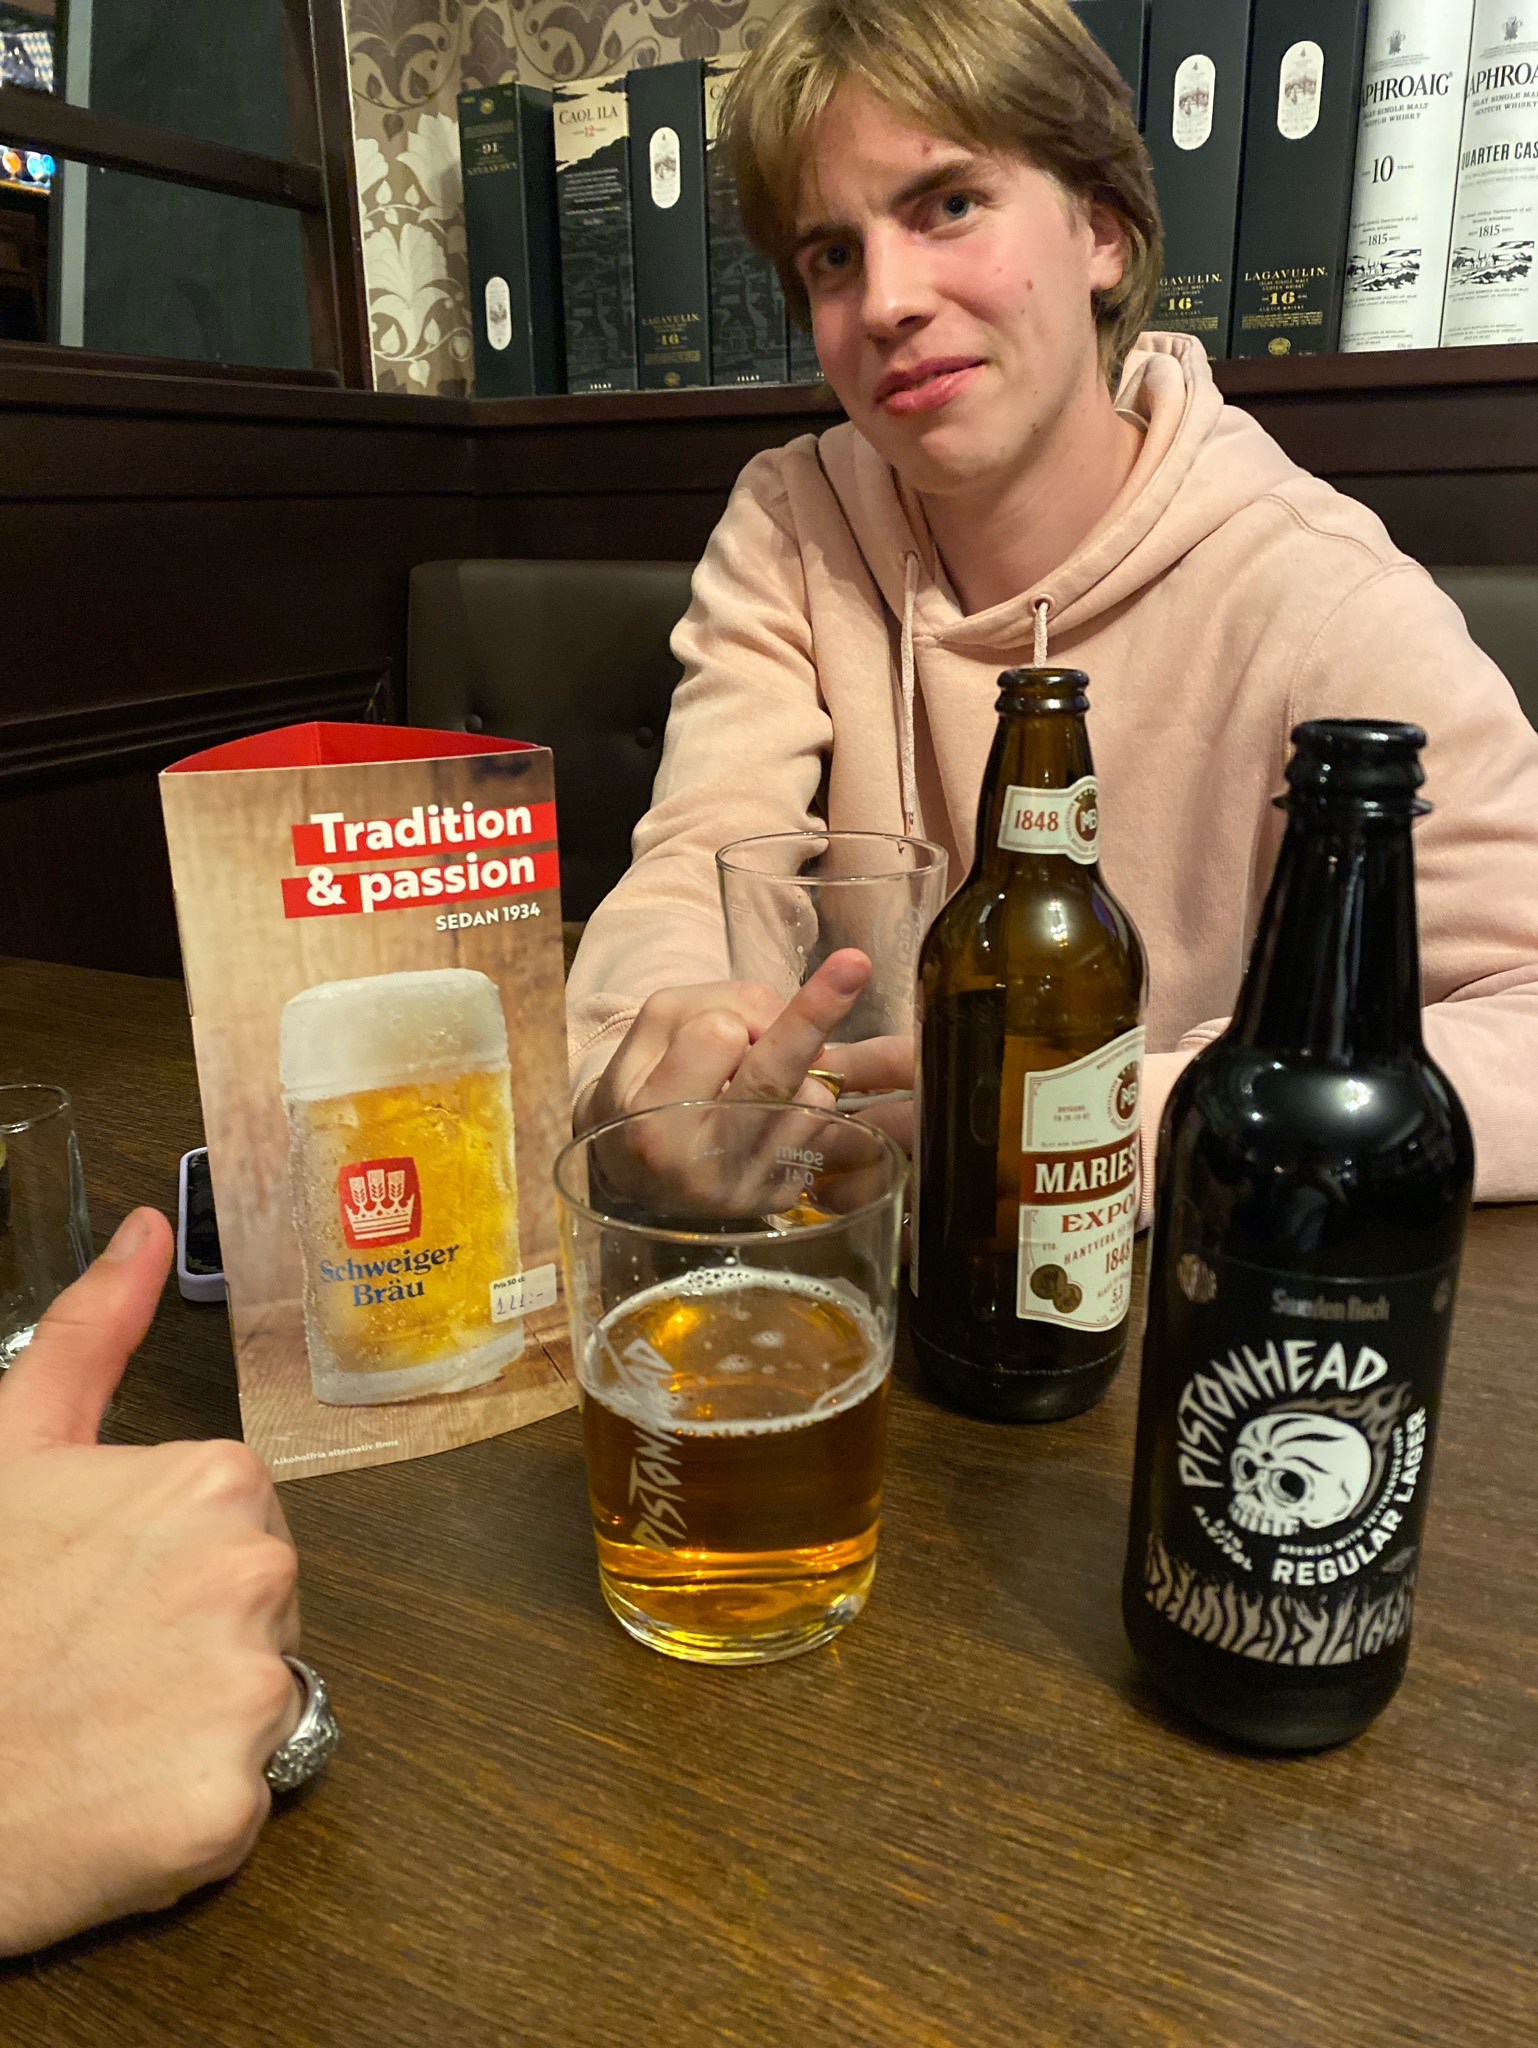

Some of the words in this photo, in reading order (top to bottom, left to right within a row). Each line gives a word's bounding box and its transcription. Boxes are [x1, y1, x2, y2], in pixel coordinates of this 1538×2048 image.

[1362, 72, 1448, 108] PHROAIG
[559, 108, 594, 125] CAOL
[1372, 155, 1394, 184] 10
[1461, 143, 1509, 170] QUARTER
[1368, 233, 1388, 246] 1815
[1479, 223, 1501, 238] 1815
[1168, 297, 1192, 310] 16
[1269, 291, 1296, 305] 16
[661, 333, 680, 346] 16
[310, 801, 533, 853] Tradition
[1015, 809, 1059, 832] 1848
[306, 866, 347, 907] &
[359, 851, 536, 914] passion
[435, 907, 500, 931] SEDAN
[502, 902, 541, 922] 1934
[320, 1244, 460, 1285] Schweiger
[352, 1279, 426, 1307] Bräu
[507, 1278, 517, 1286] 50
[1176, 1339, 1389, 1489] PISTONHEAD
[272, 1451, 327, 1466] Alkoholfria
[328, 1444, 374, 1457] alternativ
[375, 1439, 400, 1449] finns
[622, 1337, 690, 1557] PISTONAD
[1271, 1508, 1403, 1586] REGULAR
[1393, 1406, 1427, 1504] LAGER
